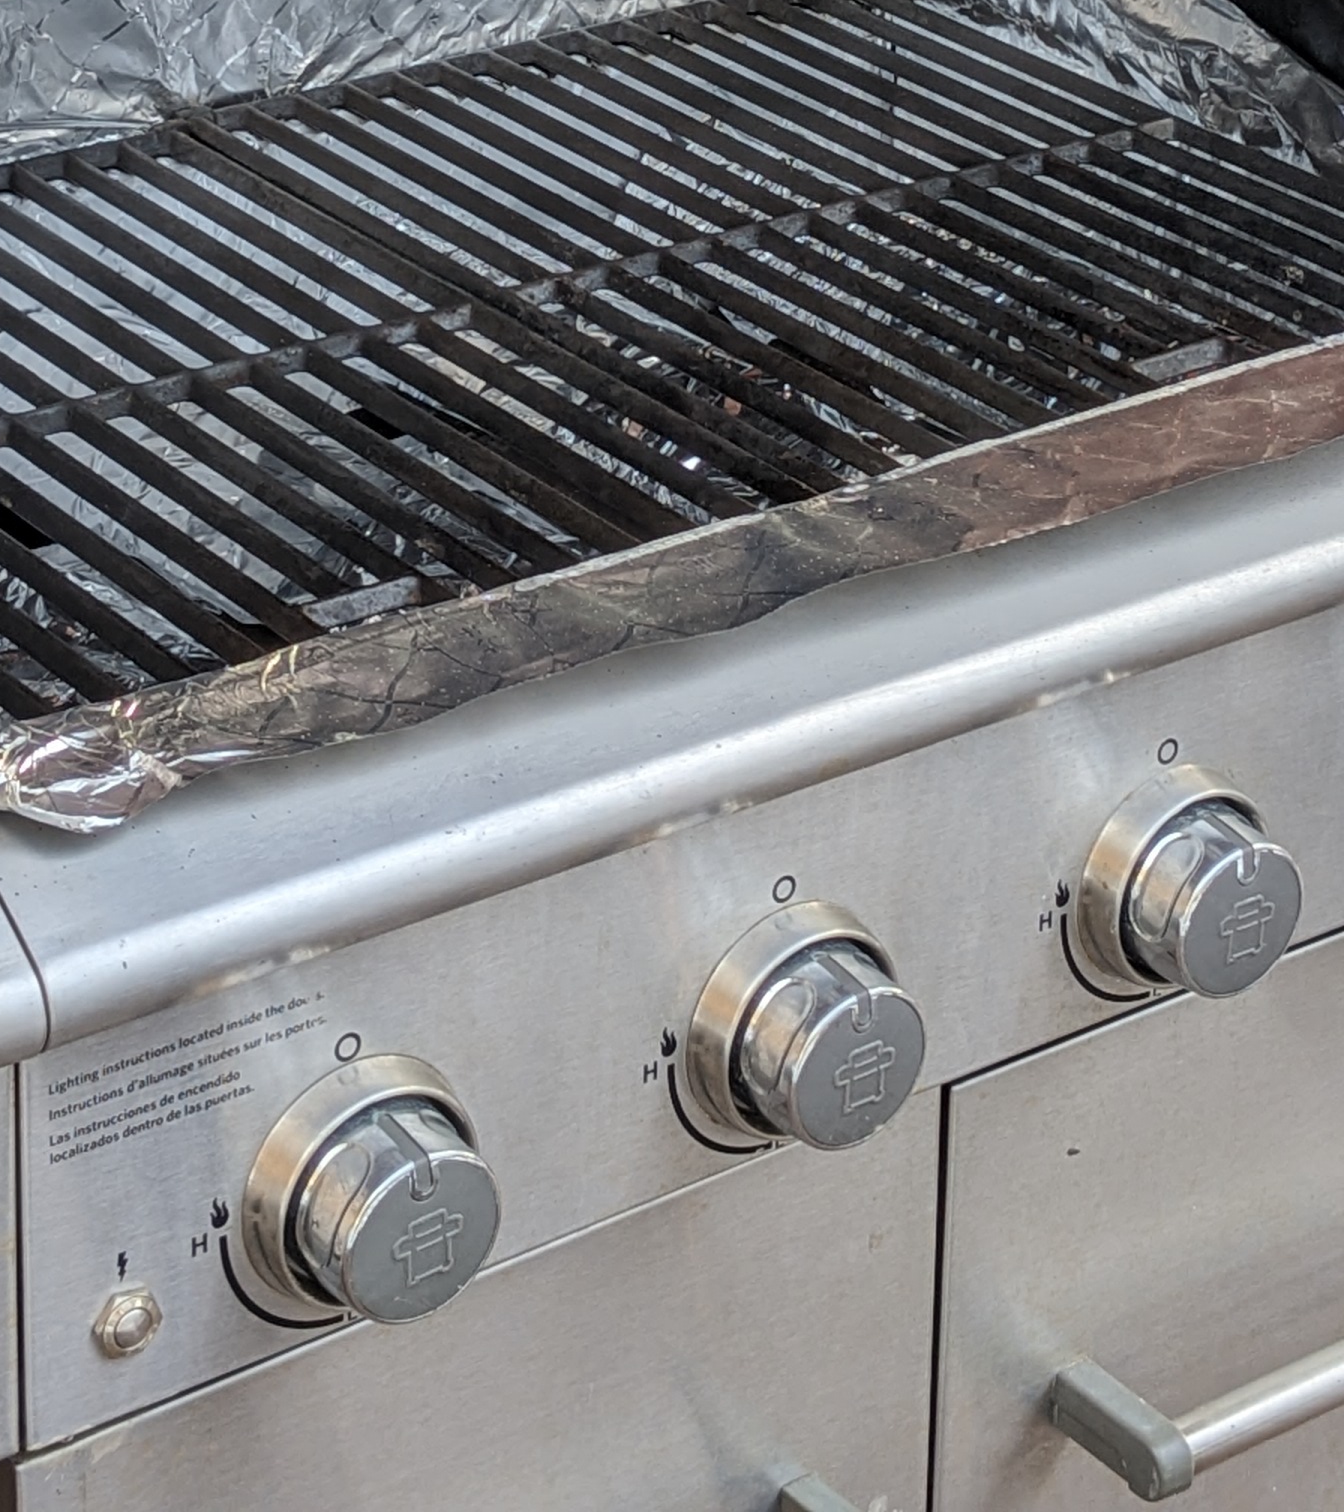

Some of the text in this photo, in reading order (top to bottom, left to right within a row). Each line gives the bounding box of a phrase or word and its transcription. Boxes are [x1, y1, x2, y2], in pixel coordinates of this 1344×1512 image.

[1039, 911, 1052, 931] H
[48, 1069, 100, 1096] Lighting
[102, 1040, 176, 1077] instructions
[177, 1023, 224, 1049] located
[226, 1011, 262, 1032] inside
[265, 1003, 285, 1018] the
[48, 1086, 124, 1121] Instructions
[127, 1061, 194, 1093] d'allumage
[197, 1045, 241, 1069] situées
[243, 1037, 262, 1051] sur
[265, 1031, 283, 1043] les
[643, 1061, 657, 1084] H
[49, 1069, 241, 1147] Las instrucciones de encendido
[50, 1084, 255, 1165] localizados dentro de las puertas.
[190, 1233, 208, 1258] H
